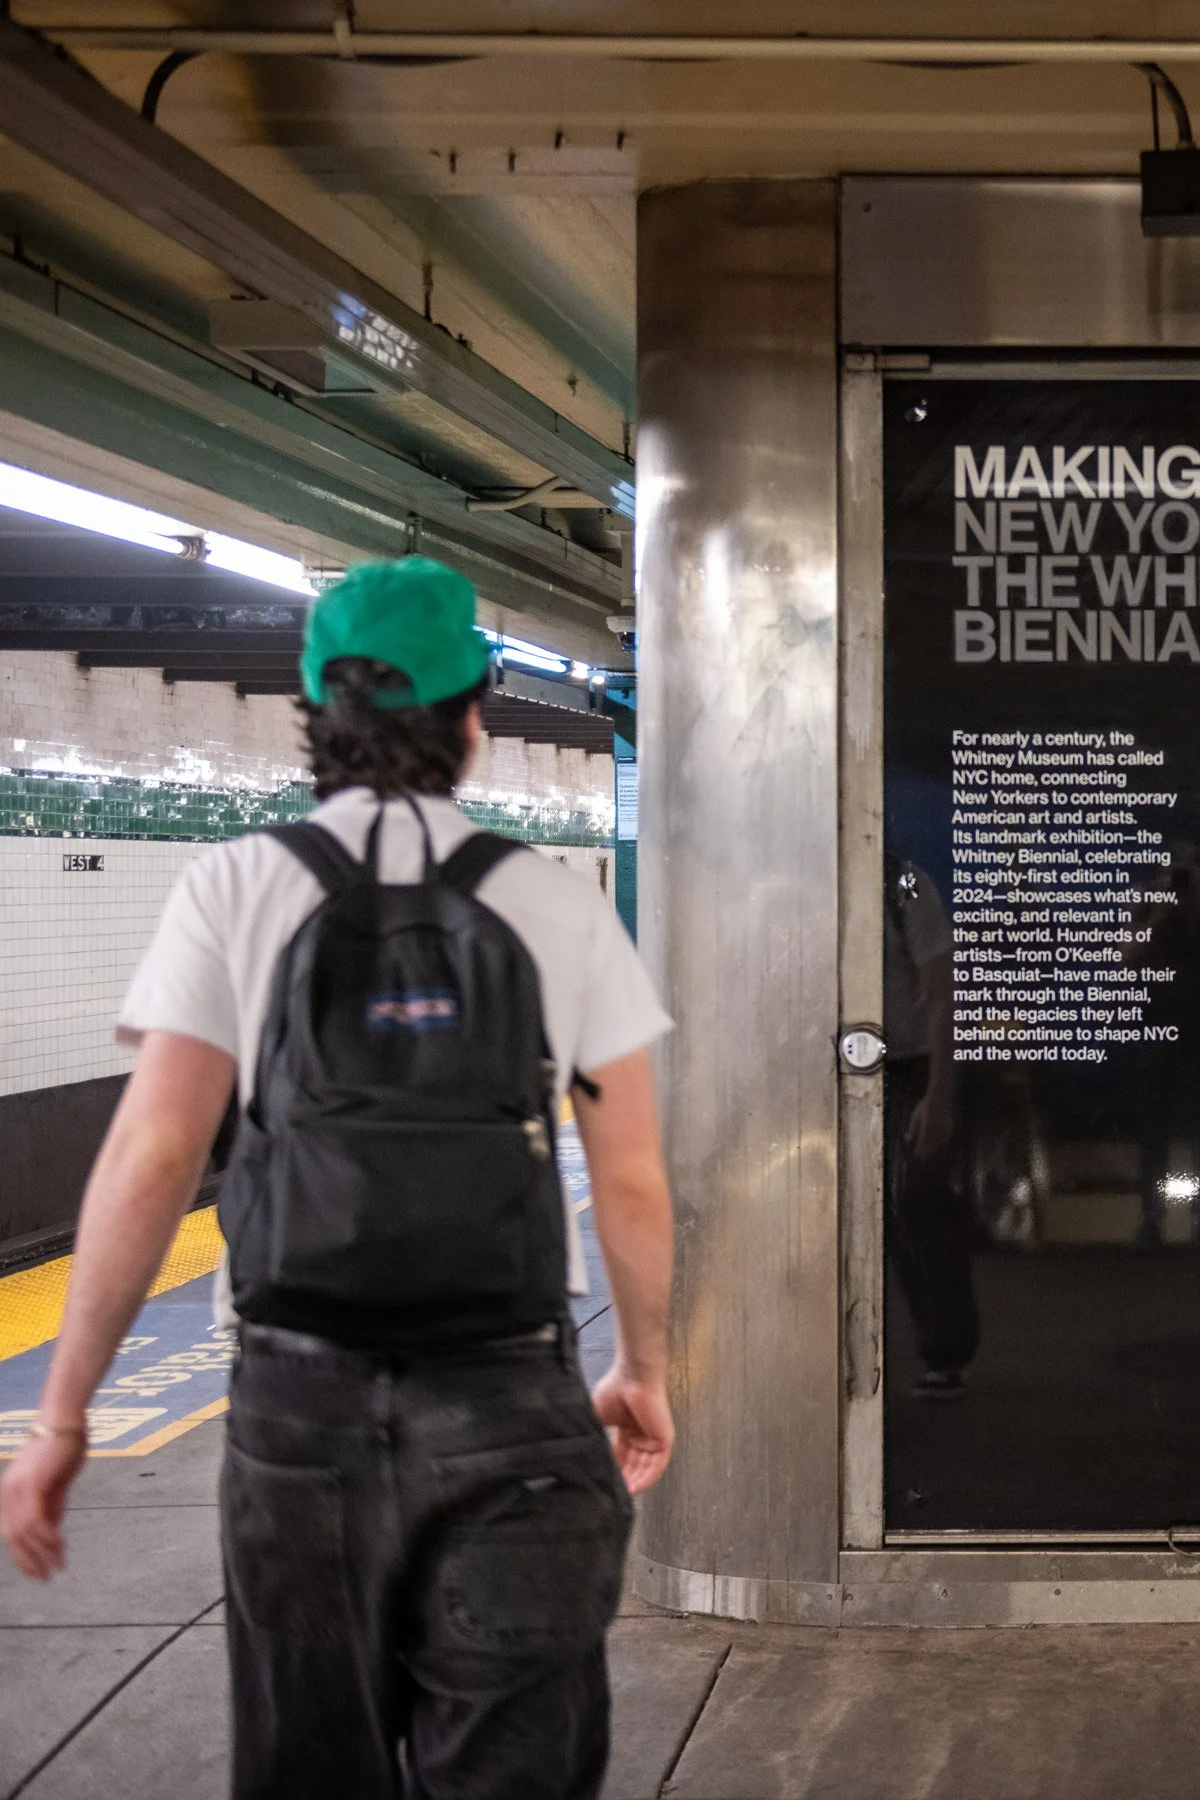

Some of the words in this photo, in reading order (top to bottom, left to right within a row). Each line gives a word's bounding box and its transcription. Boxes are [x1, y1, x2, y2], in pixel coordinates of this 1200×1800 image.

[953, 501, 1101, 553] NEW
[951, 555, 1081, 608] THE
[953, 730, 979, 745] For
[982, 731, 1030, 748] nearly
[1032, 734, 1043, 745] a
[1045, 731, 1106, 748] century,
[1109, 731, 1134, 745] the
[952, 750, 1015, 768] Whitney
[1018, 750, 1084, 765] Museum
[1087, 750, 1115, 765] has
[1118, 751, 1164, 765] called
[953, 770, 988, 785] NYC
[991, 770, 1038, 786] home,
[1041, 770, 1127, 788] connecting
[953, 790, 988, 804] New
[991, 790, 1049, 805] Yorkers
[1052, 791, 1068, 804] to
[1070, 790, 1177, 807] contemporary
[952, 809, 1025, 824] American
[1028, 810, 1050, 824] art
[1053, 809, 1082, 824] and
[1085, 809, 1137, 824] artists.
[953, 829, 973, 844] Its
[975, 829, 1046, 844] landmark
[64, 855, 91, 871] WEST
[96, 855, 104, 871] 4
[952, 849, 1015, 866] Whitney
[1018, 849, 1082, 865] Biennial,
[1085, 849, 1171, 866] celebrating
[953, 869, 972, 883] its
[975, 868, 1058, 886] eighty-first
[1060, 869, 1113, 883] edition
[1116, 869, 1129, 883] in
[1144, 892, 1178, 904] new,
[953, 908, 1017, 925] exciting,
[1020, 908, 1050, 923] and
[1053, 908, 1115, 923] relevant
[1118, 908, 1131, 922] in
[953, 928, 978, 942] the
[981, 928, 1004, 942] art
[1007, 928, 1053, 942] world.
[1057, 928, 1133, 942] Hundreds
[1135, 928, 1152, 942] of
[953, 968, 969, 982] to
[1094, 967, 1137, 982] made
[1141, 967, 1176, 982] their
[954, 987, 993, 1001] mark
[996, 987, 1055, 1004] through
[1059, 987, 1084, 1001] the
[1087, 987, 1151, 1003] Biennial,
[953, 1007, 982, 1021] and
[986, 1007, 1011, 1021] the
[1014, 1007, 1078, 1024] legacies
[1081, 1007, 1115, 1024] they
[1118, 1007, 1143, 1021] left
[954, 1026, 1005, 1041] behind
[1007, 1026, 1073, 1041] continue
[1076, 1027, 1092, 1041] to
[1094, 1026, 1141, 1043] shape
[1144, 1026, 1178, 1041] NYC
[953, 1046, 983, 1060] and
[986, 1046, 1011, 1060] the
[1014, 1046, 1058, 1060] world
[1061, 1046, 1107, 1063] today.
